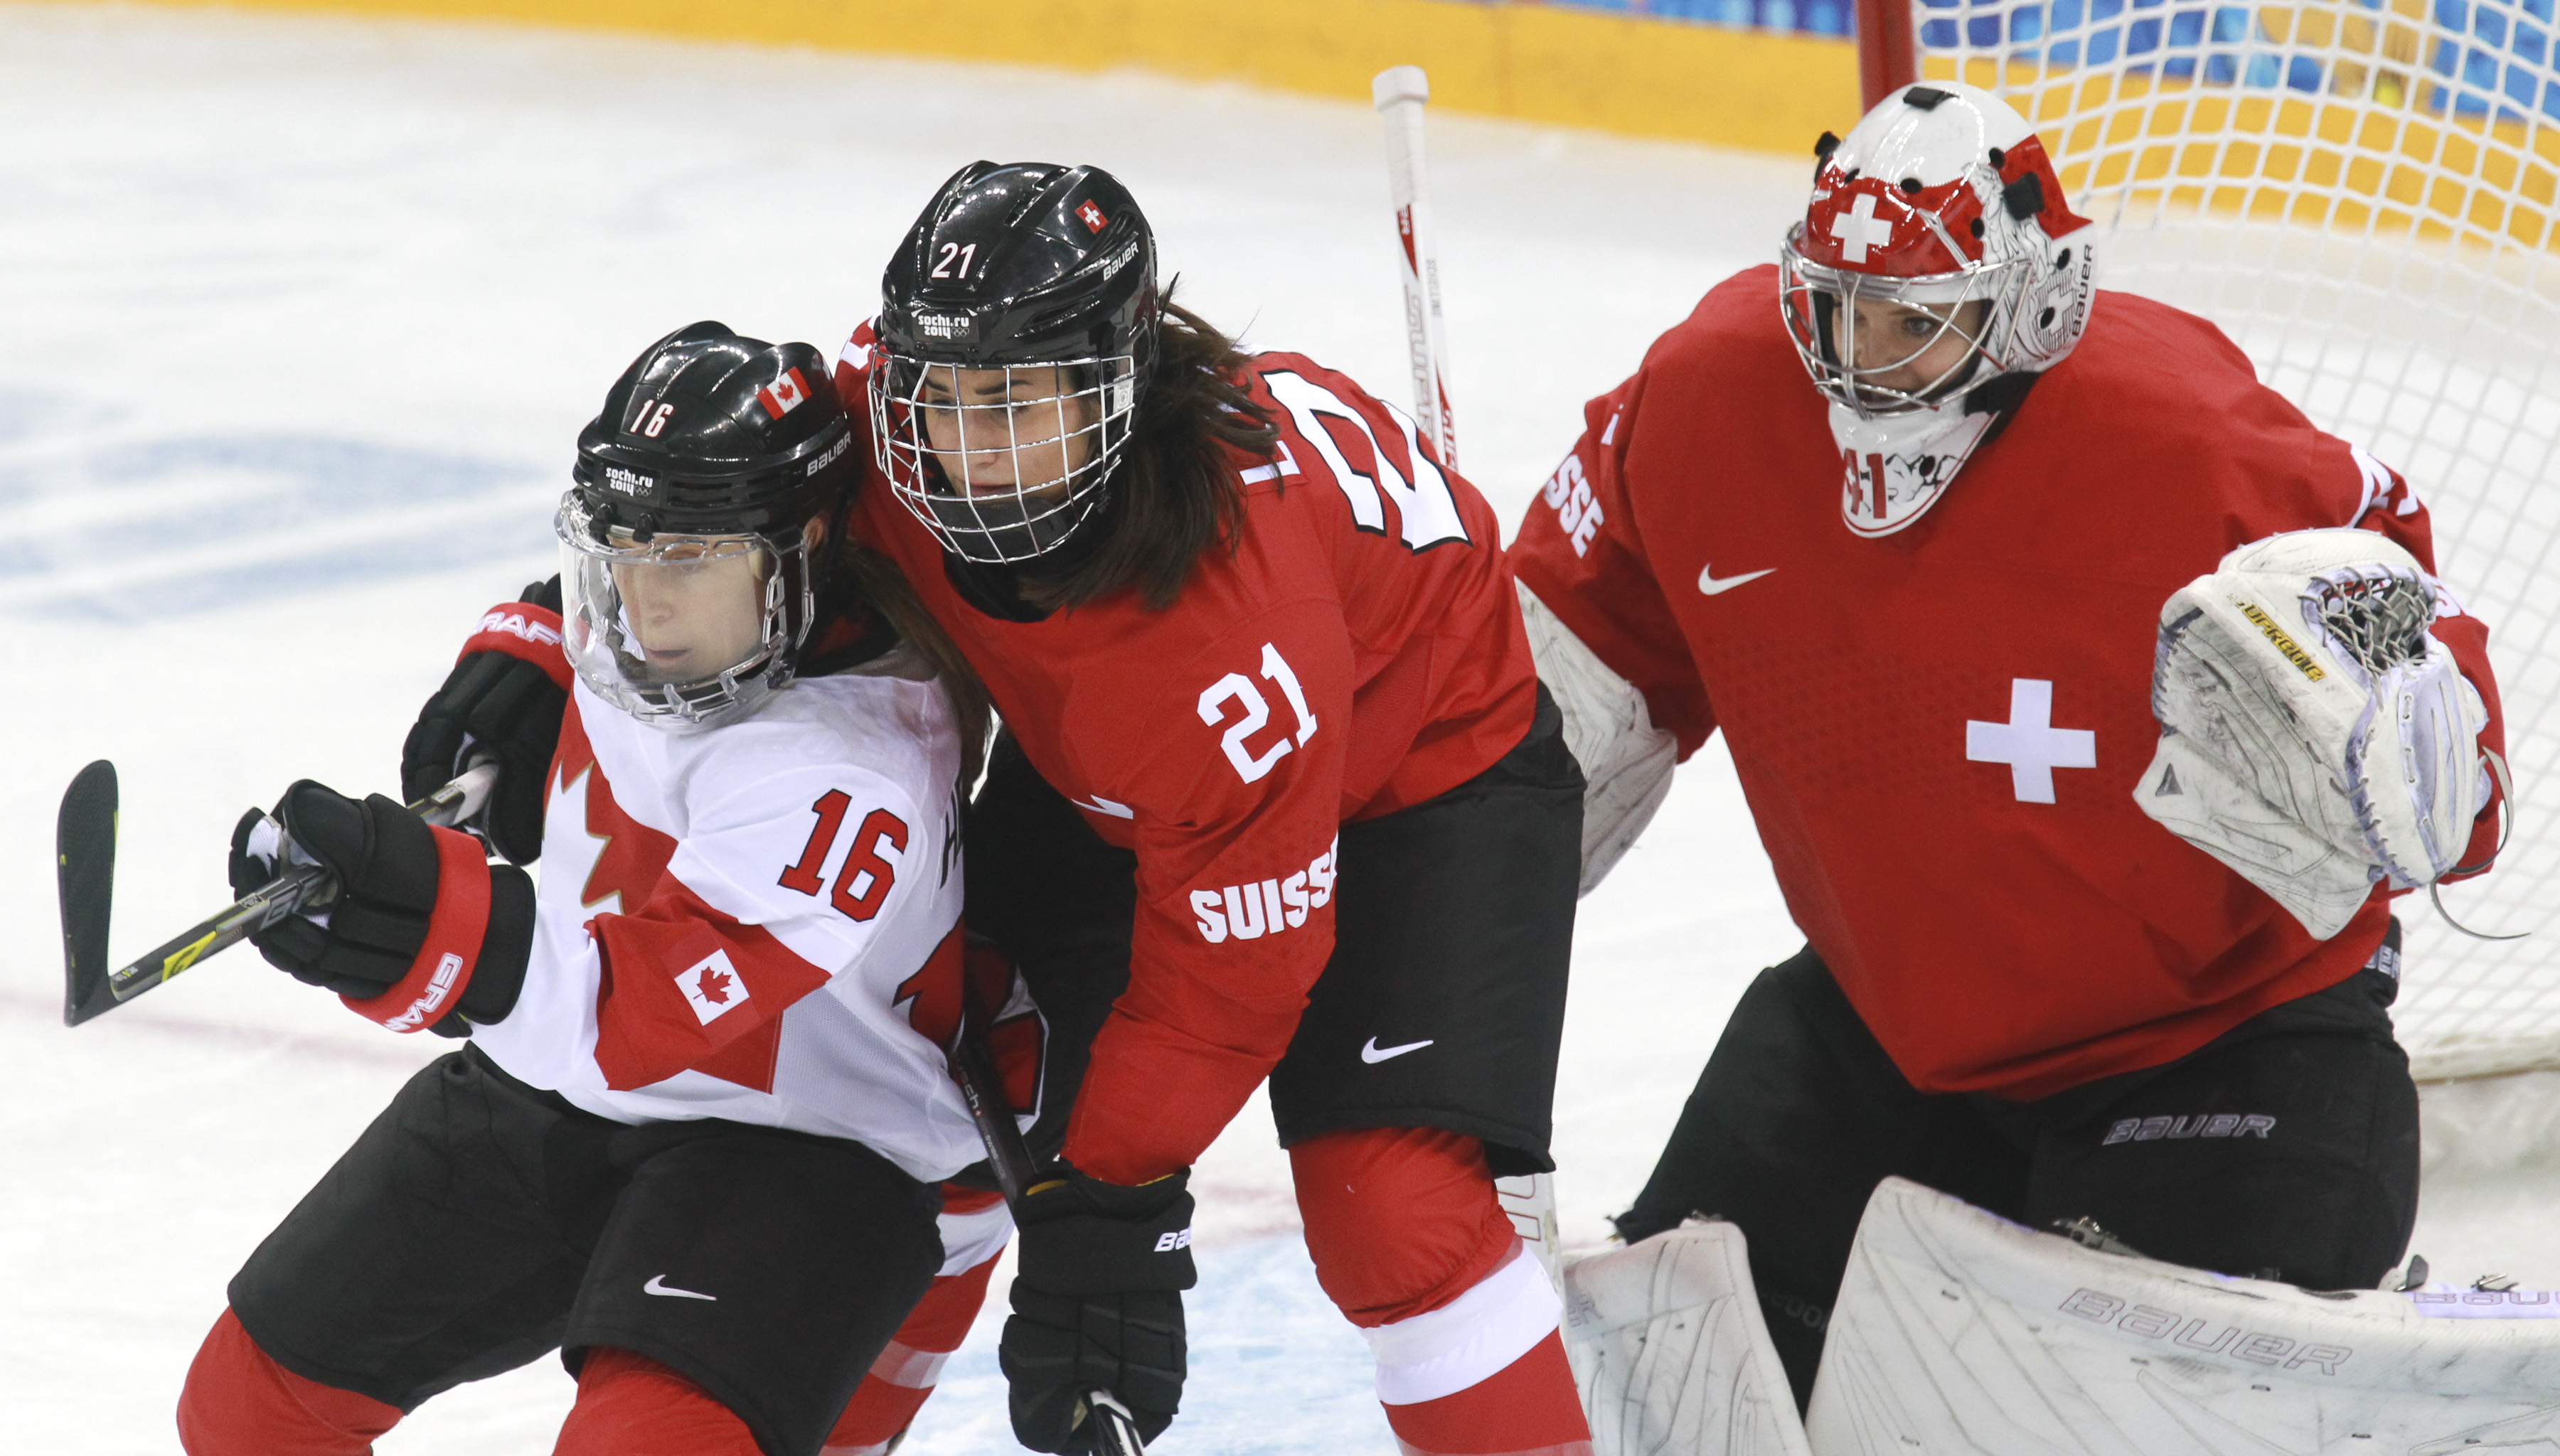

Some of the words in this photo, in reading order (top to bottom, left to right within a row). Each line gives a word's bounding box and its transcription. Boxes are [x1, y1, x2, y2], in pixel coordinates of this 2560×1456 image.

[931, 242, 976, 279] 21
[1102, 241, 1138, 282] BAUER
[2071, 244, 2094, 337] BAUER
[917, 314, 969, 328] sochi.ru
[924, 326, 951, 340] 2014
[629, 398, 674, 439] 16
[806, 430, 852, 477] BAUER
[605, 467, 654, 488] sochi.ru
[609, 478, 634, 497] 2014
[1196, 642, 1318, 785] 21
[777, 788, 910, 923] 16
[2102, 1113, 2276, 1146] BAUER
[2413, 1285, 2559, 1305] BAU
[2058, 1288, 2353, 1376] BAUER
